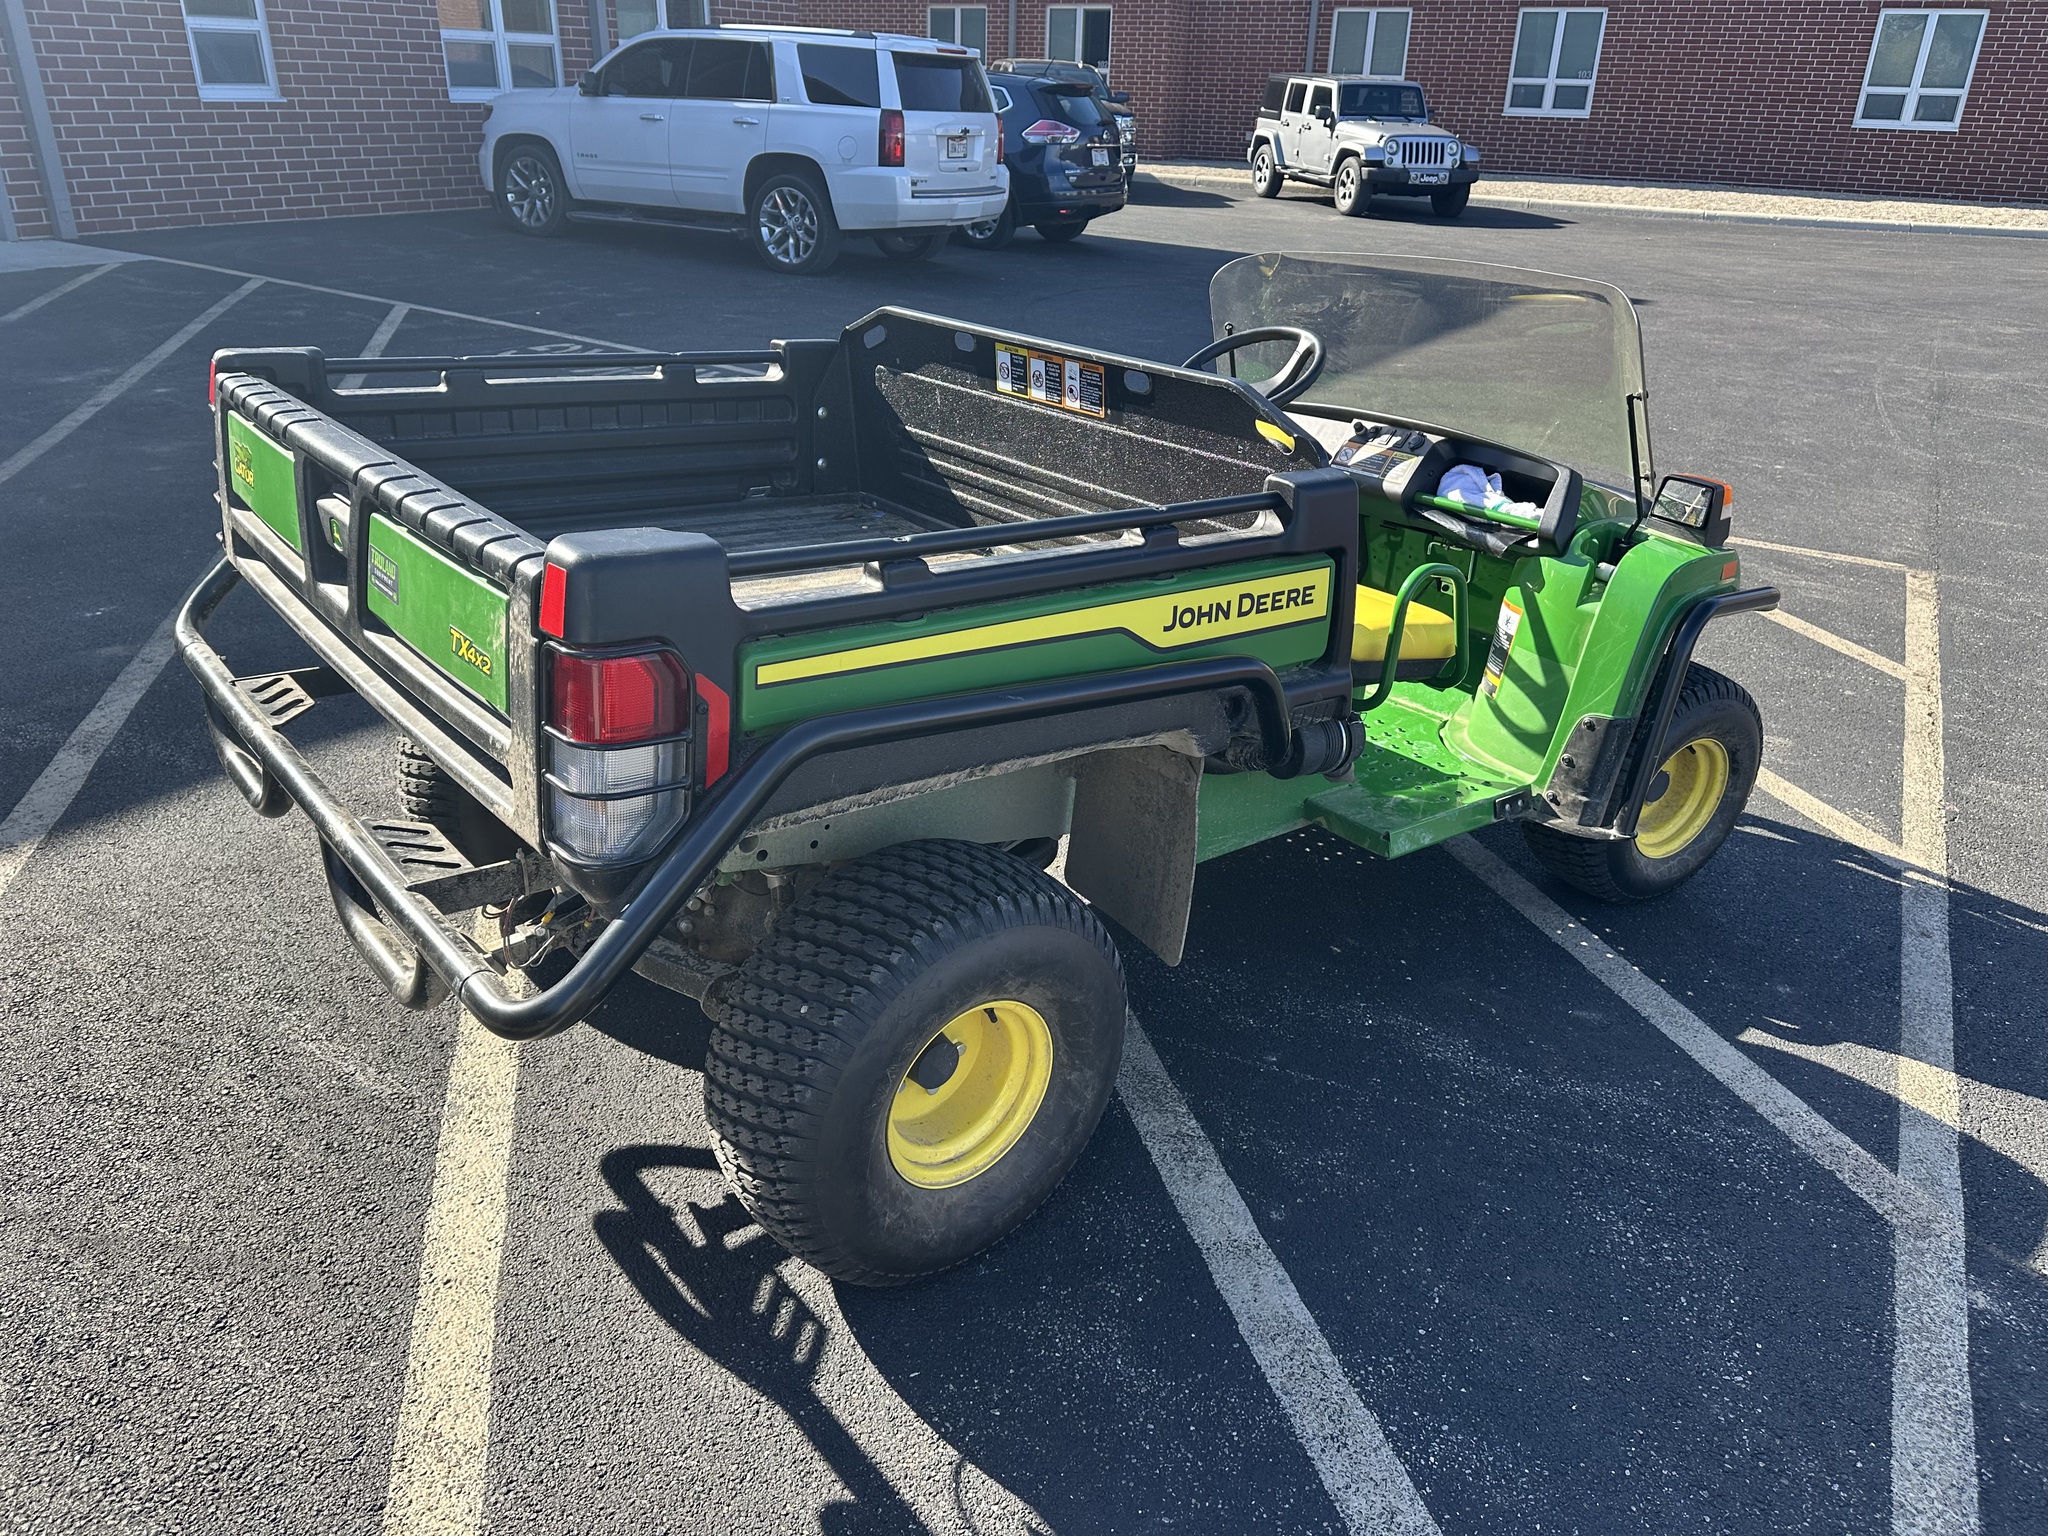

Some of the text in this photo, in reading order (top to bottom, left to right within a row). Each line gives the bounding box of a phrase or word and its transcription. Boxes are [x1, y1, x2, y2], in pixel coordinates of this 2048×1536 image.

[1577, 70, 1592, 79] 103
[1420, 174, 1438, 184] Jeep
[234, 456, 255, 488] GATOR
[1162, 584, 1316, 633] JOHN DEERE
[449, 627, 491, 676] TX4x2
